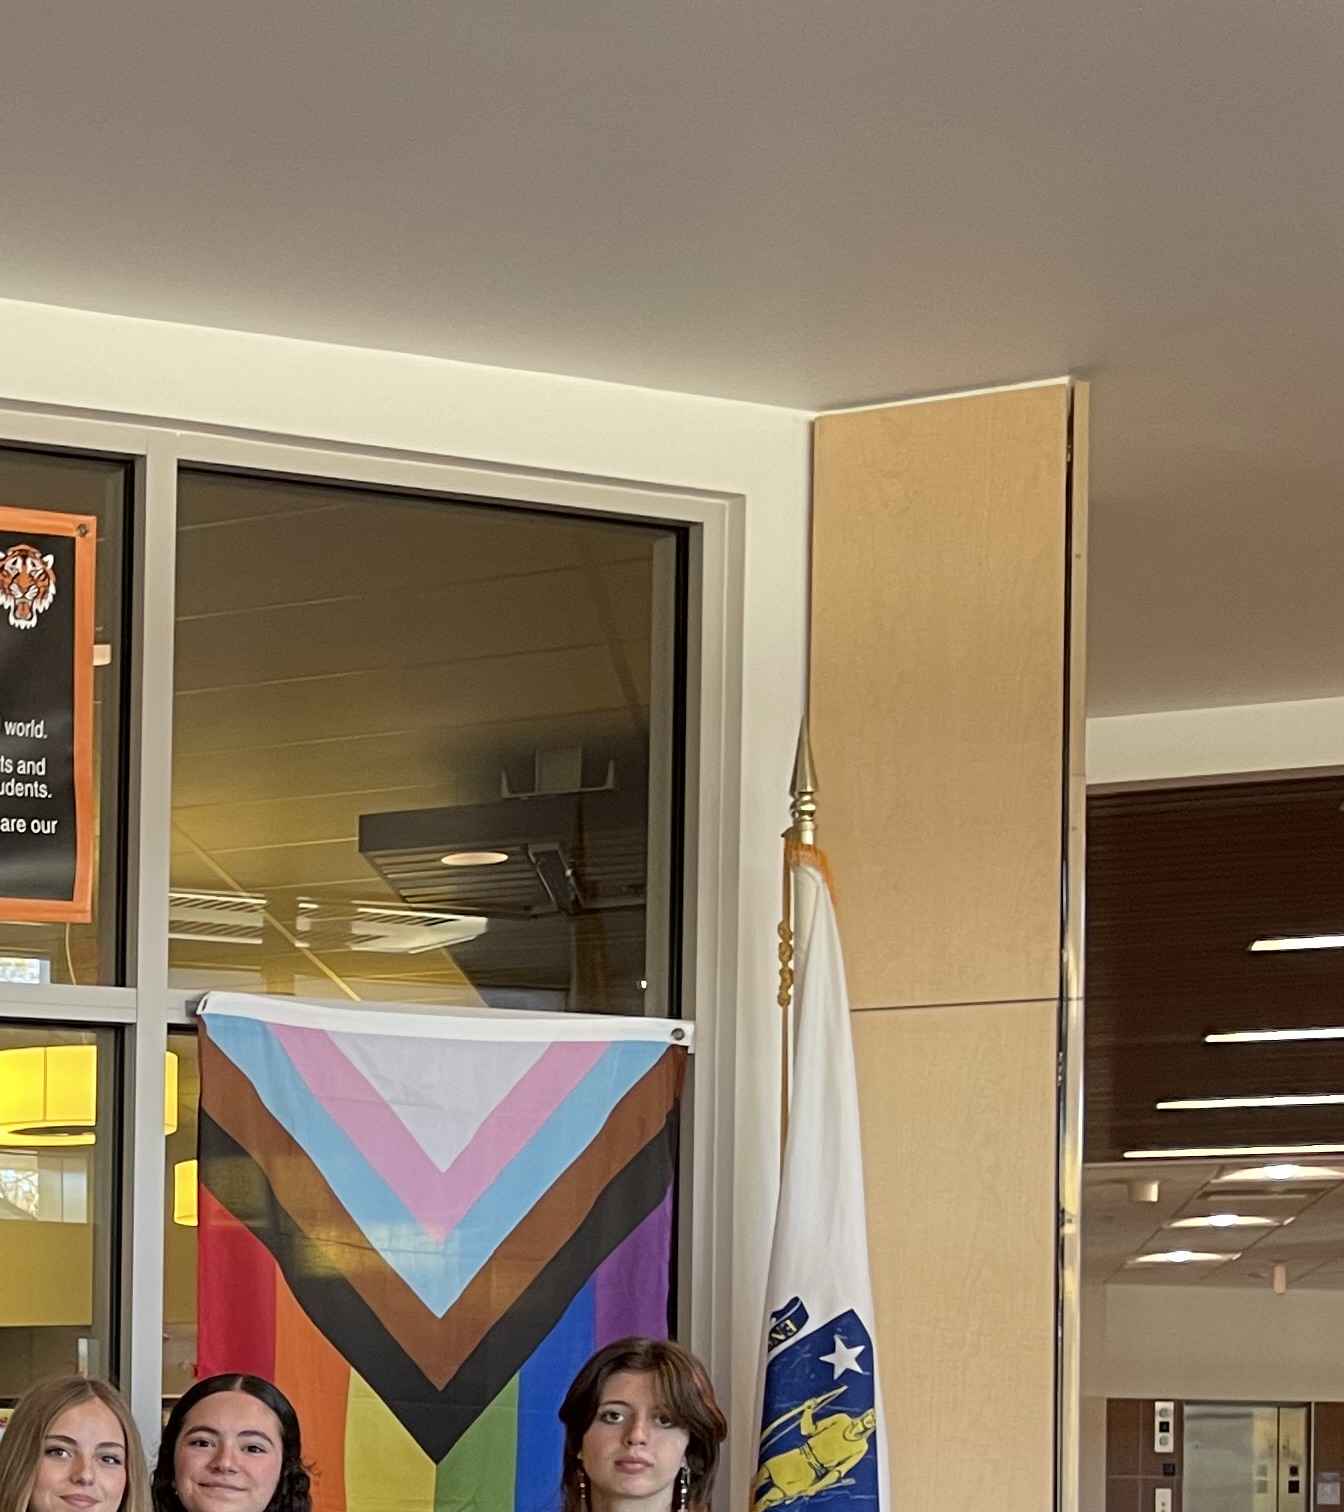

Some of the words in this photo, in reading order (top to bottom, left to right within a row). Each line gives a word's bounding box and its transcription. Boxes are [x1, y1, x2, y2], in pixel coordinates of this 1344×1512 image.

[4, 719, 46, 738] world.
[16, 757, 45, 775] and
[0, 817, 26, 831] are
[30, 819, 57, 833] our
